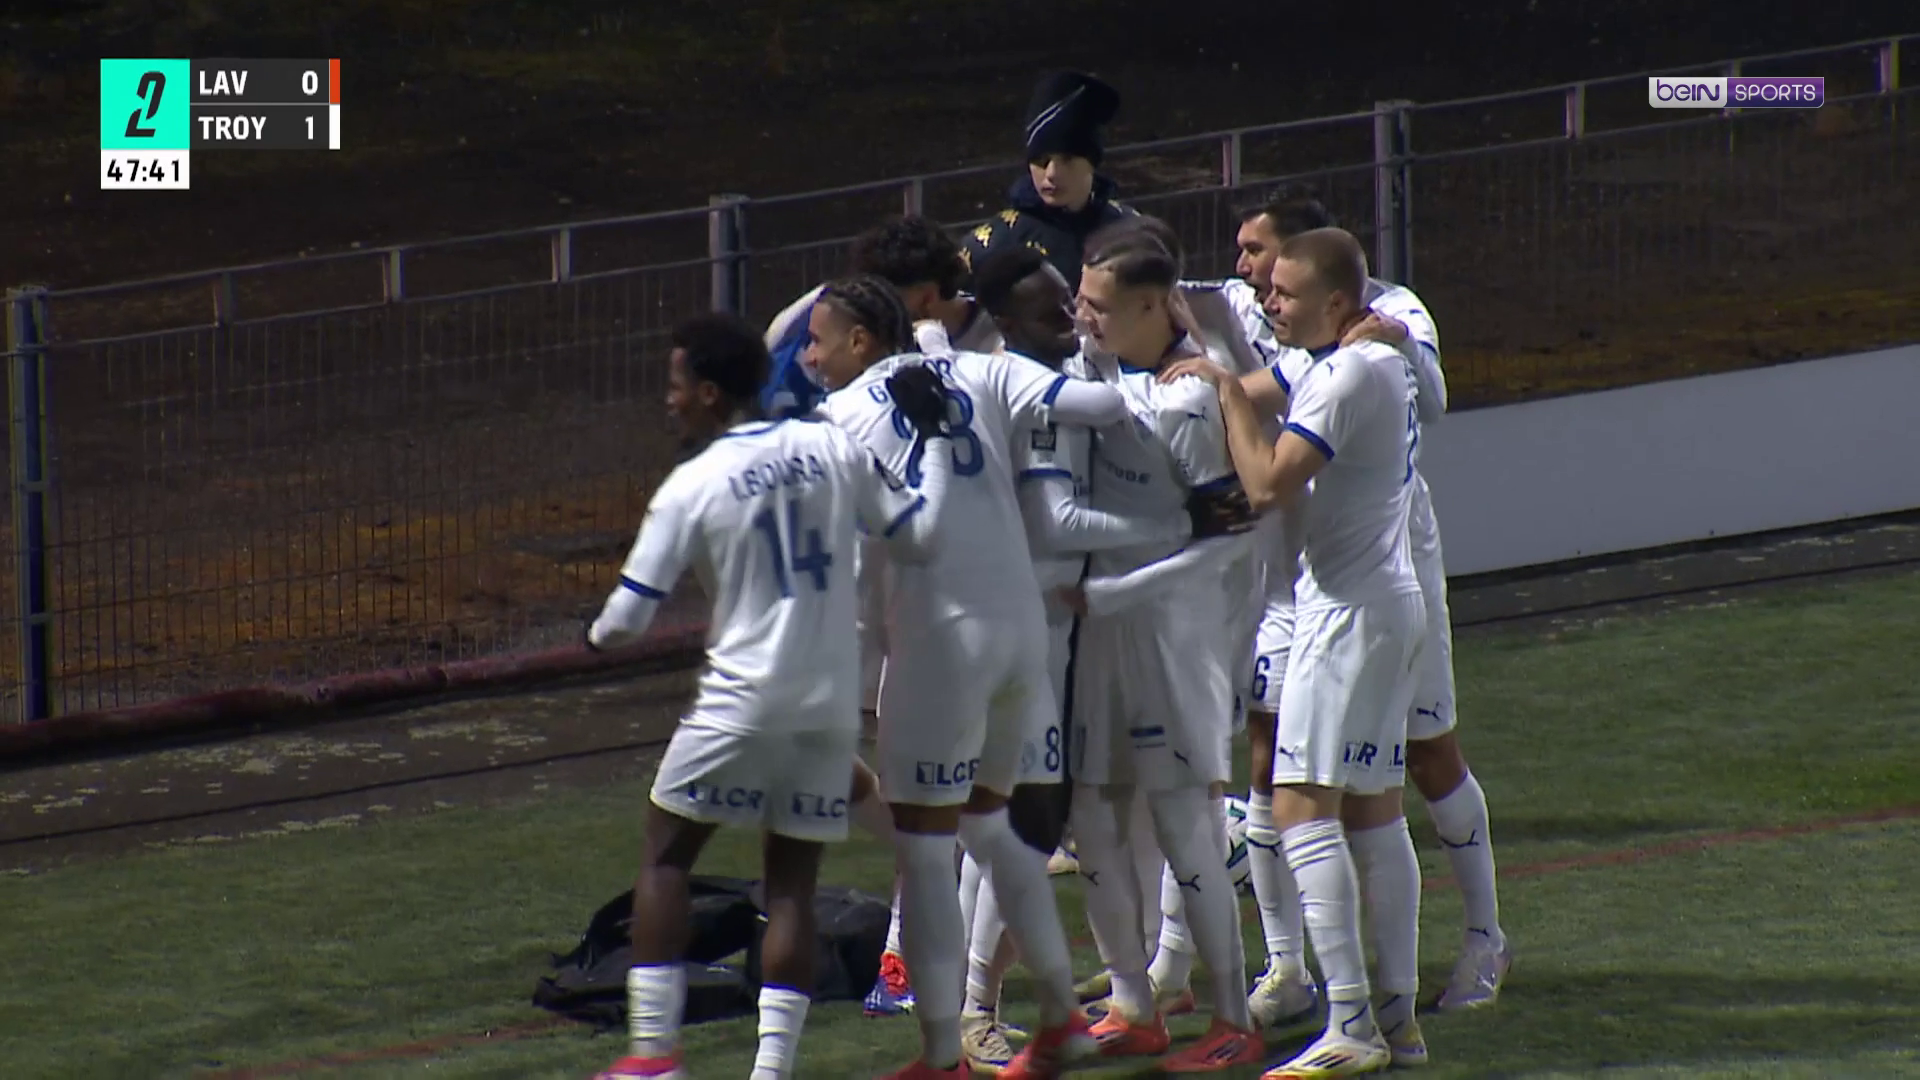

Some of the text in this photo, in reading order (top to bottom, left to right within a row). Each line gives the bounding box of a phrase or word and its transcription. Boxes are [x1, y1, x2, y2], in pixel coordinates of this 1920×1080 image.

[755, 499, 833, 599] 14
[1251, 655, 1271, 701] 6
[1045, 725, 1060, 773] 8
